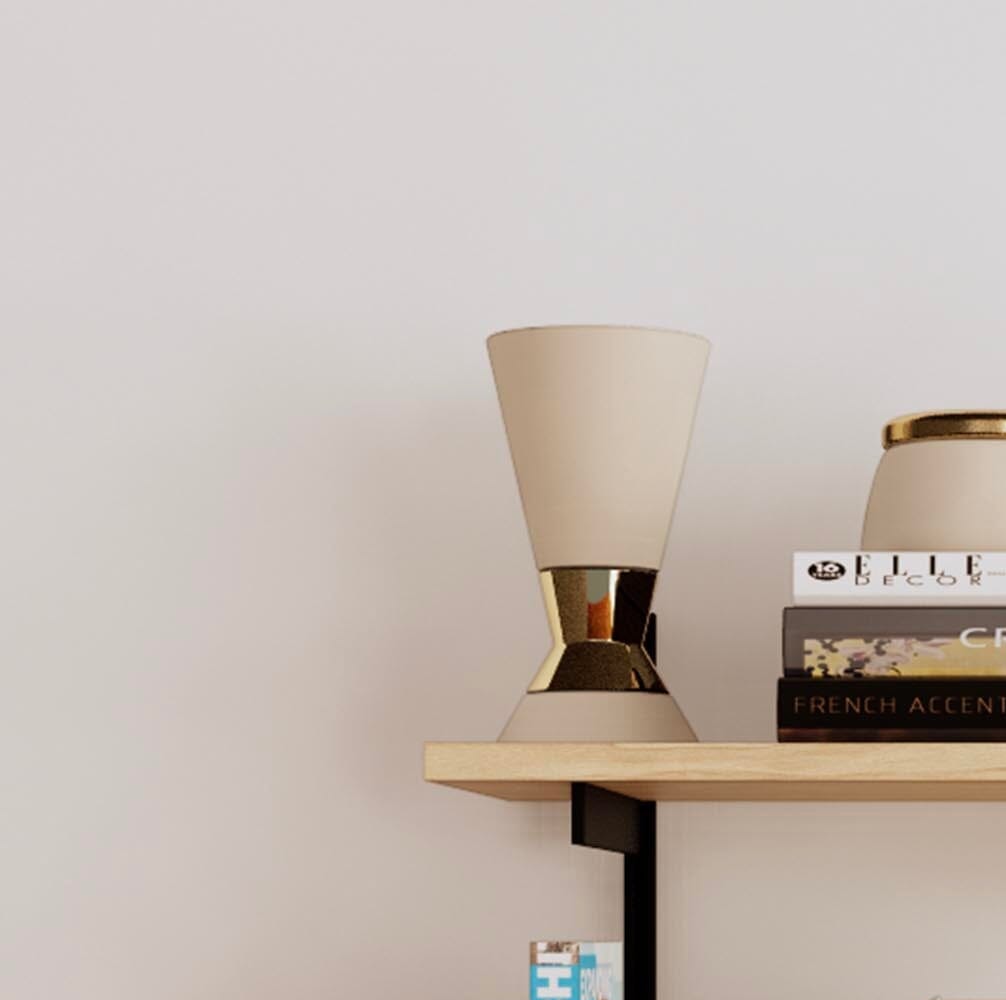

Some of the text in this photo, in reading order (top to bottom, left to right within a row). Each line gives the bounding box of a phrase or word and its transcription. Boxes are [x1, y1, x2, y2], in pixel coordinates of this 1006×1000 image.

[855, 555, 982, 576] ELLE
[855, 574, 982, 586] DECOR
[794, 696, 897, 714] FRENCH
